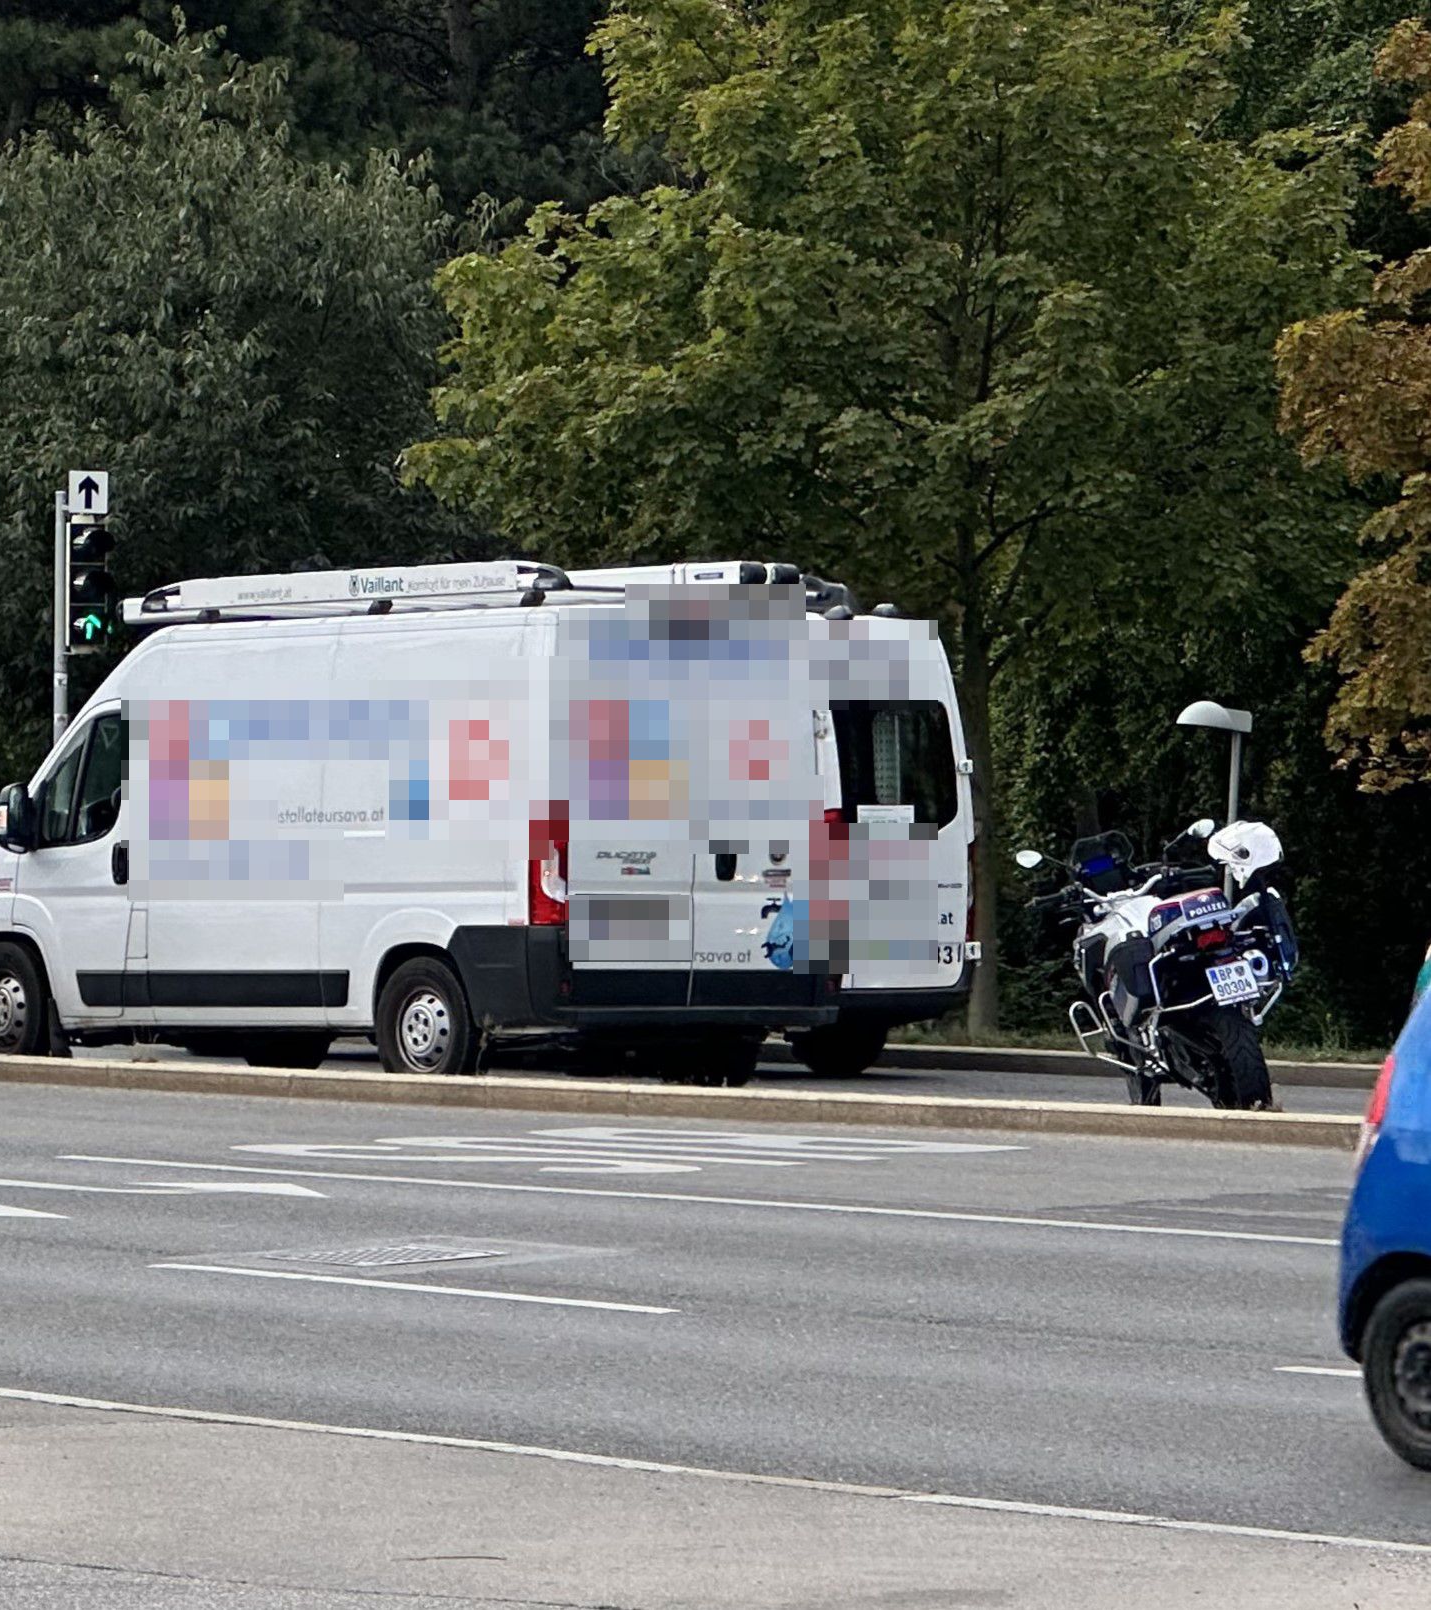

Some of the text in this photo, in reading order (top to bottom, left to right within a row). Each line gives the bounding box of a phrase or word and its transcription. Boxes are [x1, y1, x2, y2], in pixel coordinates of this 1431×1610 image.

[361, 577, 404, 594] Vaillant
[277, 806, 384, 824] stallateursava.at
[1190, 902, 1226, 917] POLIZEI
[1218, 967, 1232, 981] BP
[1217, 979, 1252, 997] 90304
